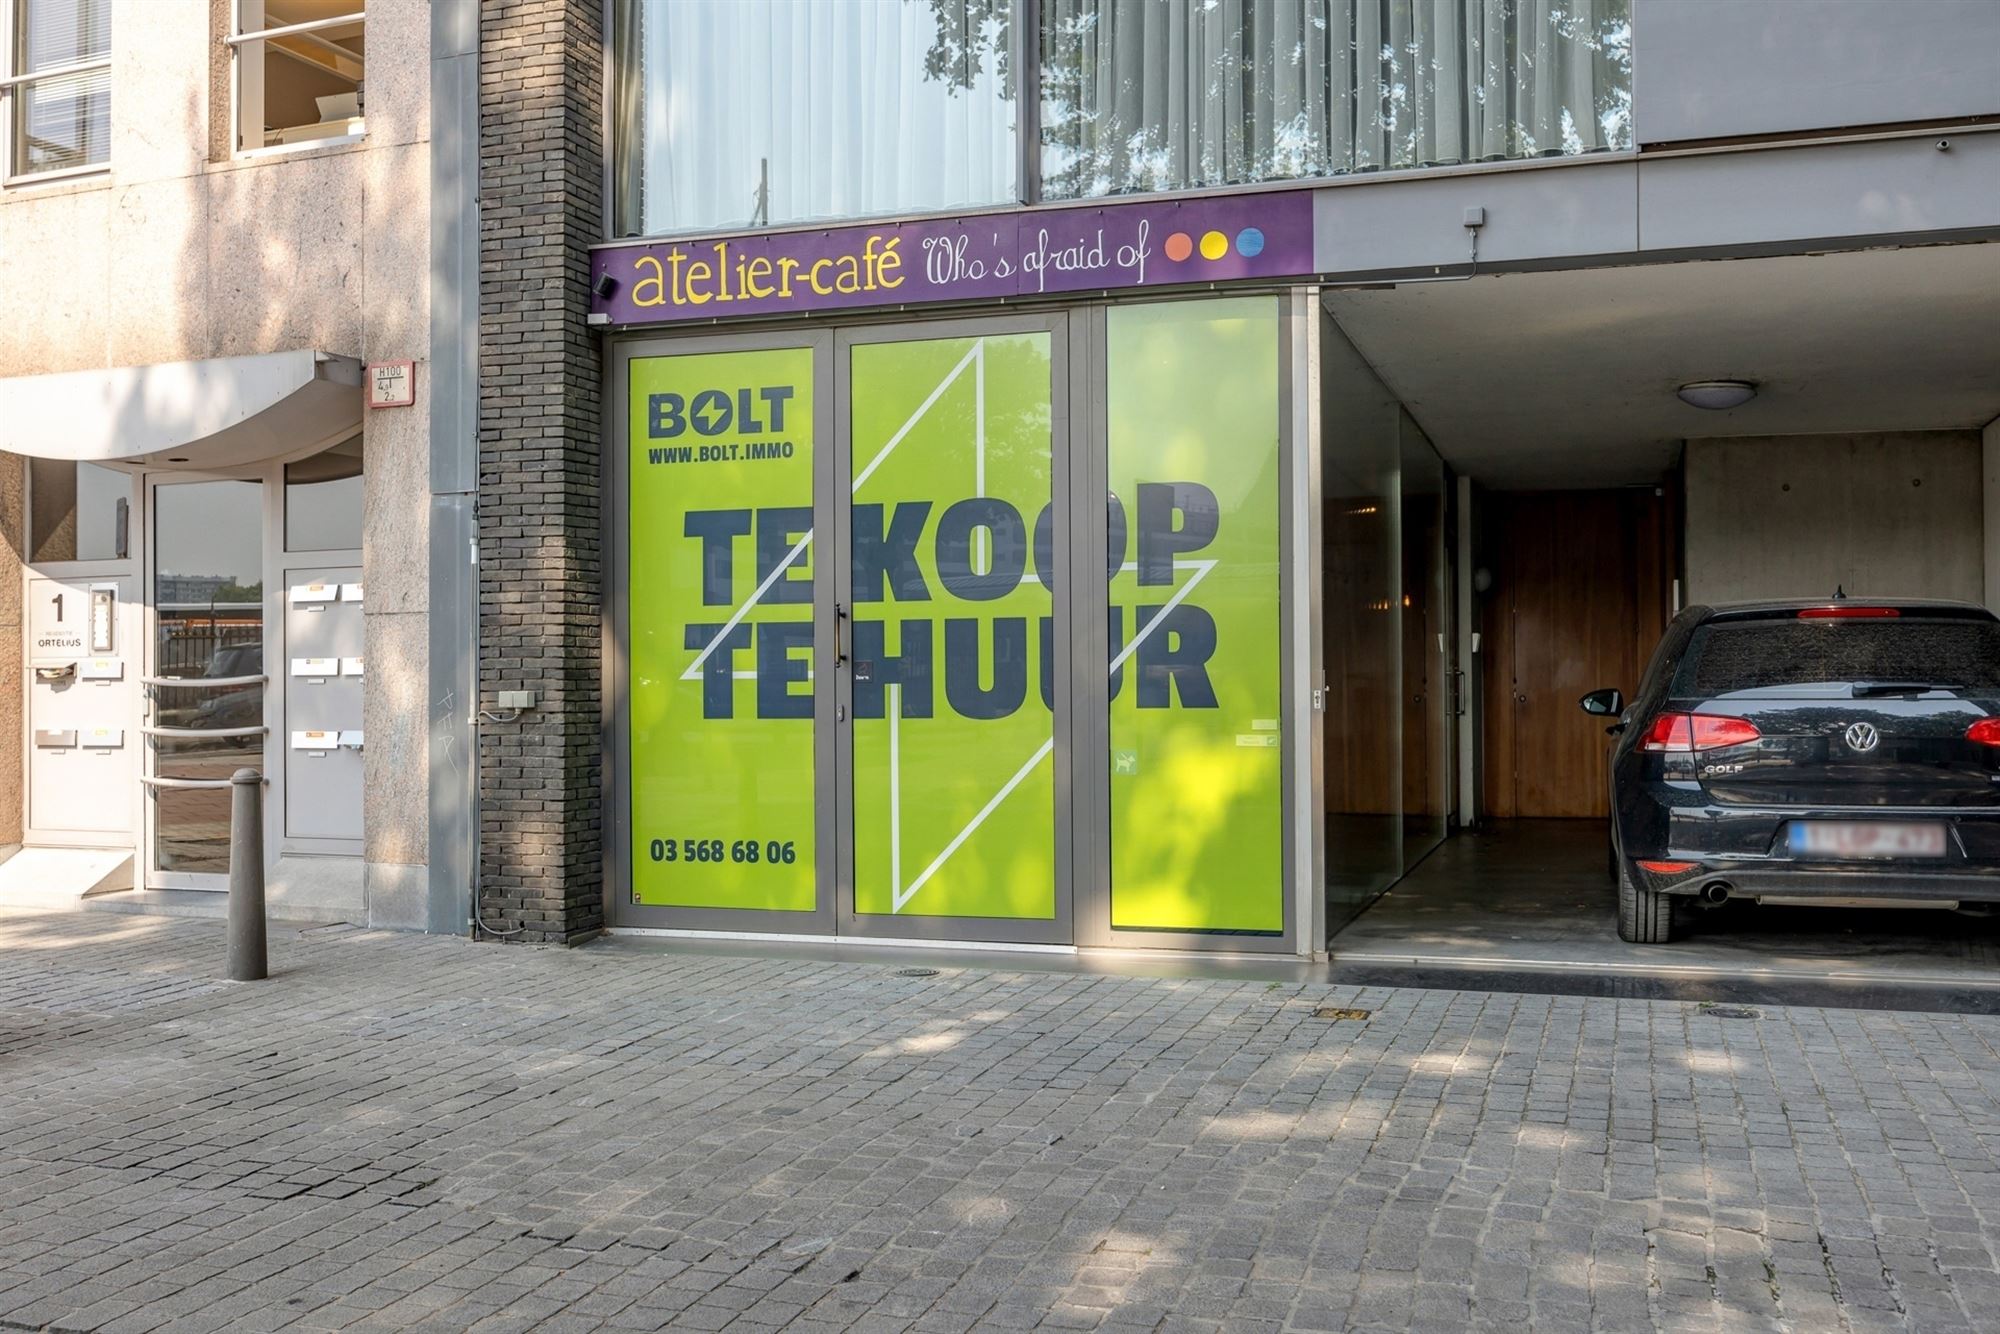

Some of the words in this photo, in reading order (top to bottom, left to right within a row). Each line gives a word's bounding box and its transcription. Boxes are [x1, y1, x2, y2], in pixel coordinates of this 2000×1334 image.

[631, 235, 905, 307] atelier-café
[922, 233, 1017, 285] Who's
[1023, 228, 1110, 293] afraid
[1117, 219, 1151, 284] of
[379, 366, 402, 377] H100
[648, 385, 794, 439] BOLT
[648, 441, 794, 465] WWW.BOLT.IMMO
[52, 593, 63, 622] 1
[1704, 764, 1744, 774] GOLF
[650, 839, 677, 862] 03
[684, 839, 724, 863] 568
[731, 840, 759, 863] 68
[766, 841, 796, 864] 06
